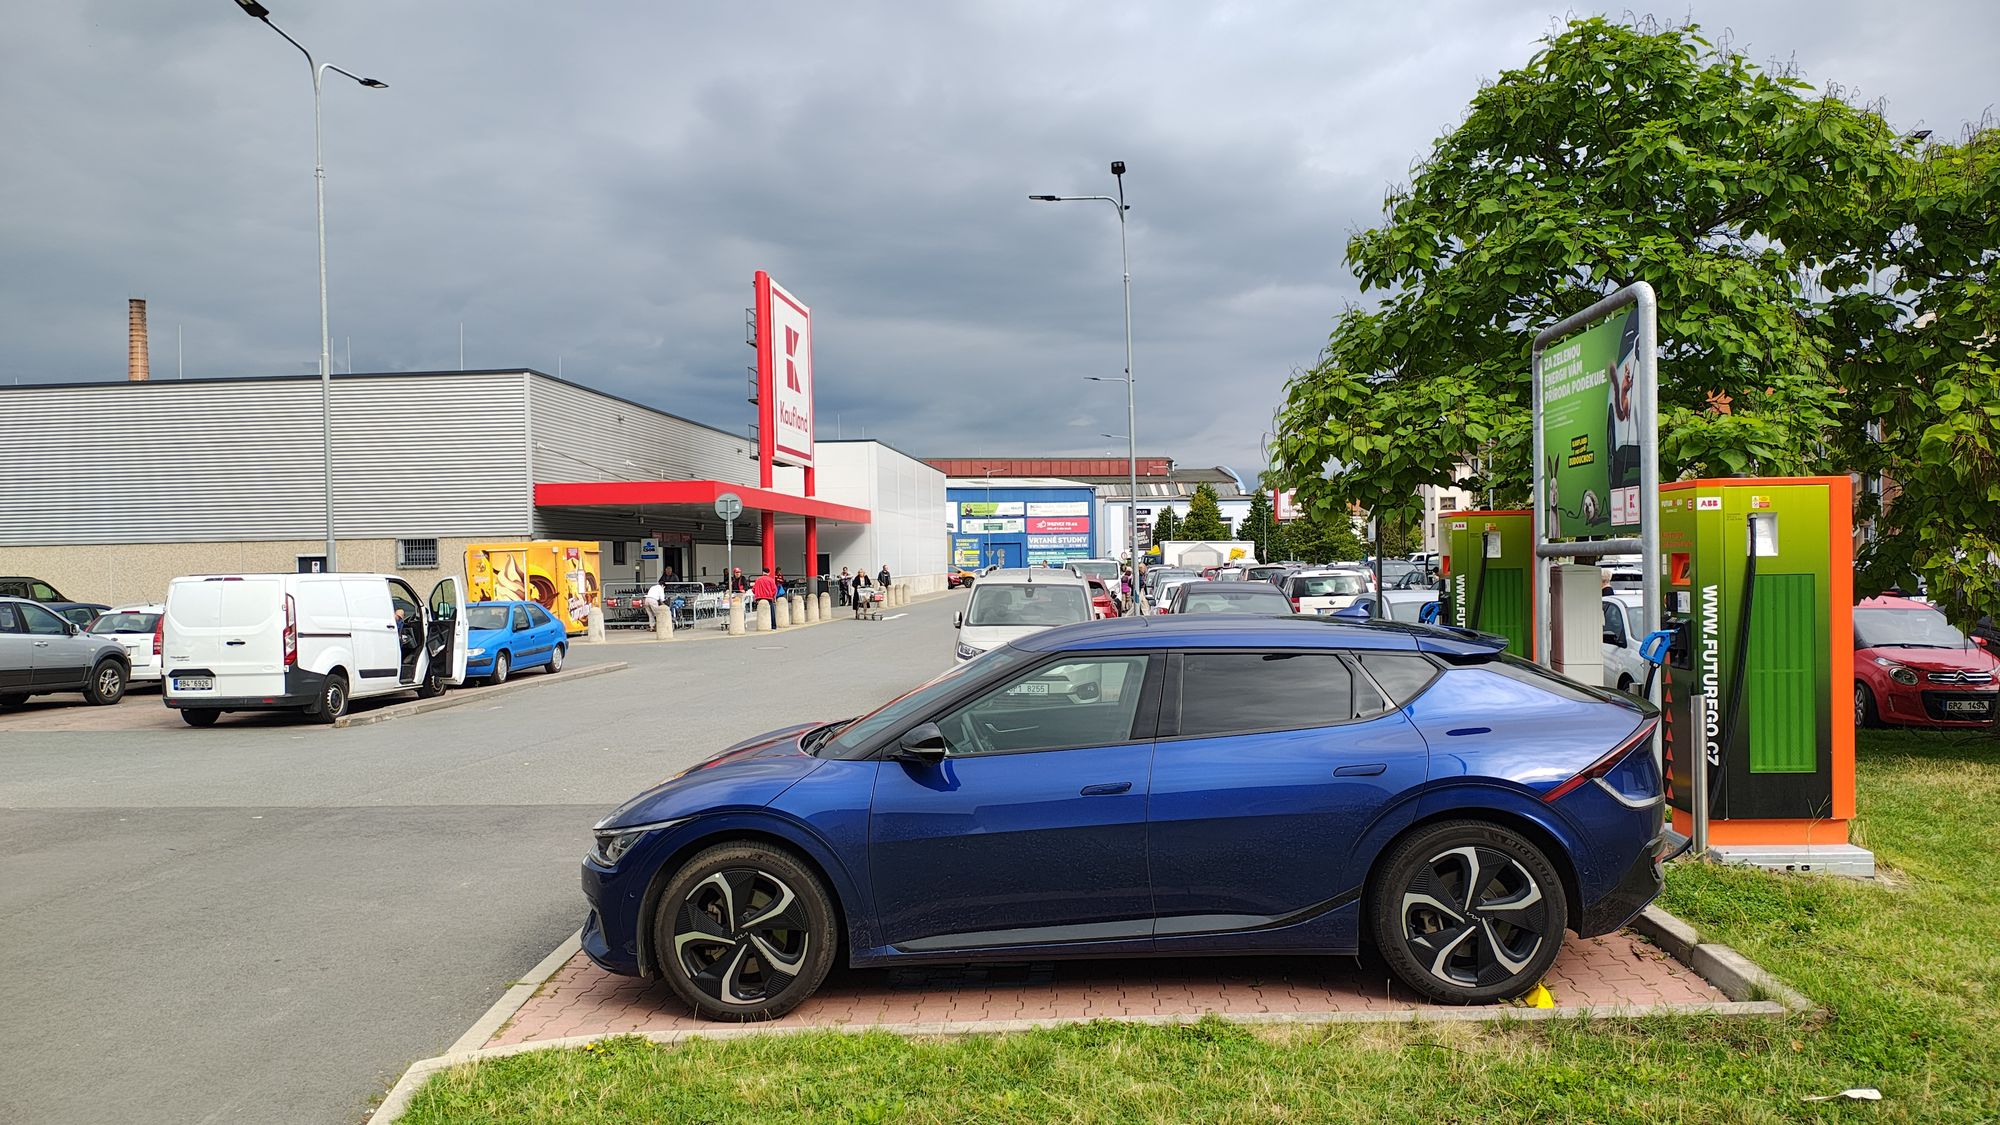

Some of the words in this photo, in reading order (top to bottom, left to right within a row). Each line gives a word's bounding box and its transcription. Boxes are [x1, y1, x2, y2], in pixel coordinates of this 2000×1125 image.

[1544, 357, 1553, 371] ZA
[1553, 343, 1581, 367] ZELENOU
[1568, 360, 1583, 378] VÁM
[1545, 382, 1571, 404] PŘÍRODA
[1572, 369, 1608, 393] PODĚKUJE.
[780, 400, 808, 433] Kaufland
[1029, 536, 1056, 544] VRTANÉ
[1058, 536, 1087, 544] STUDNY
